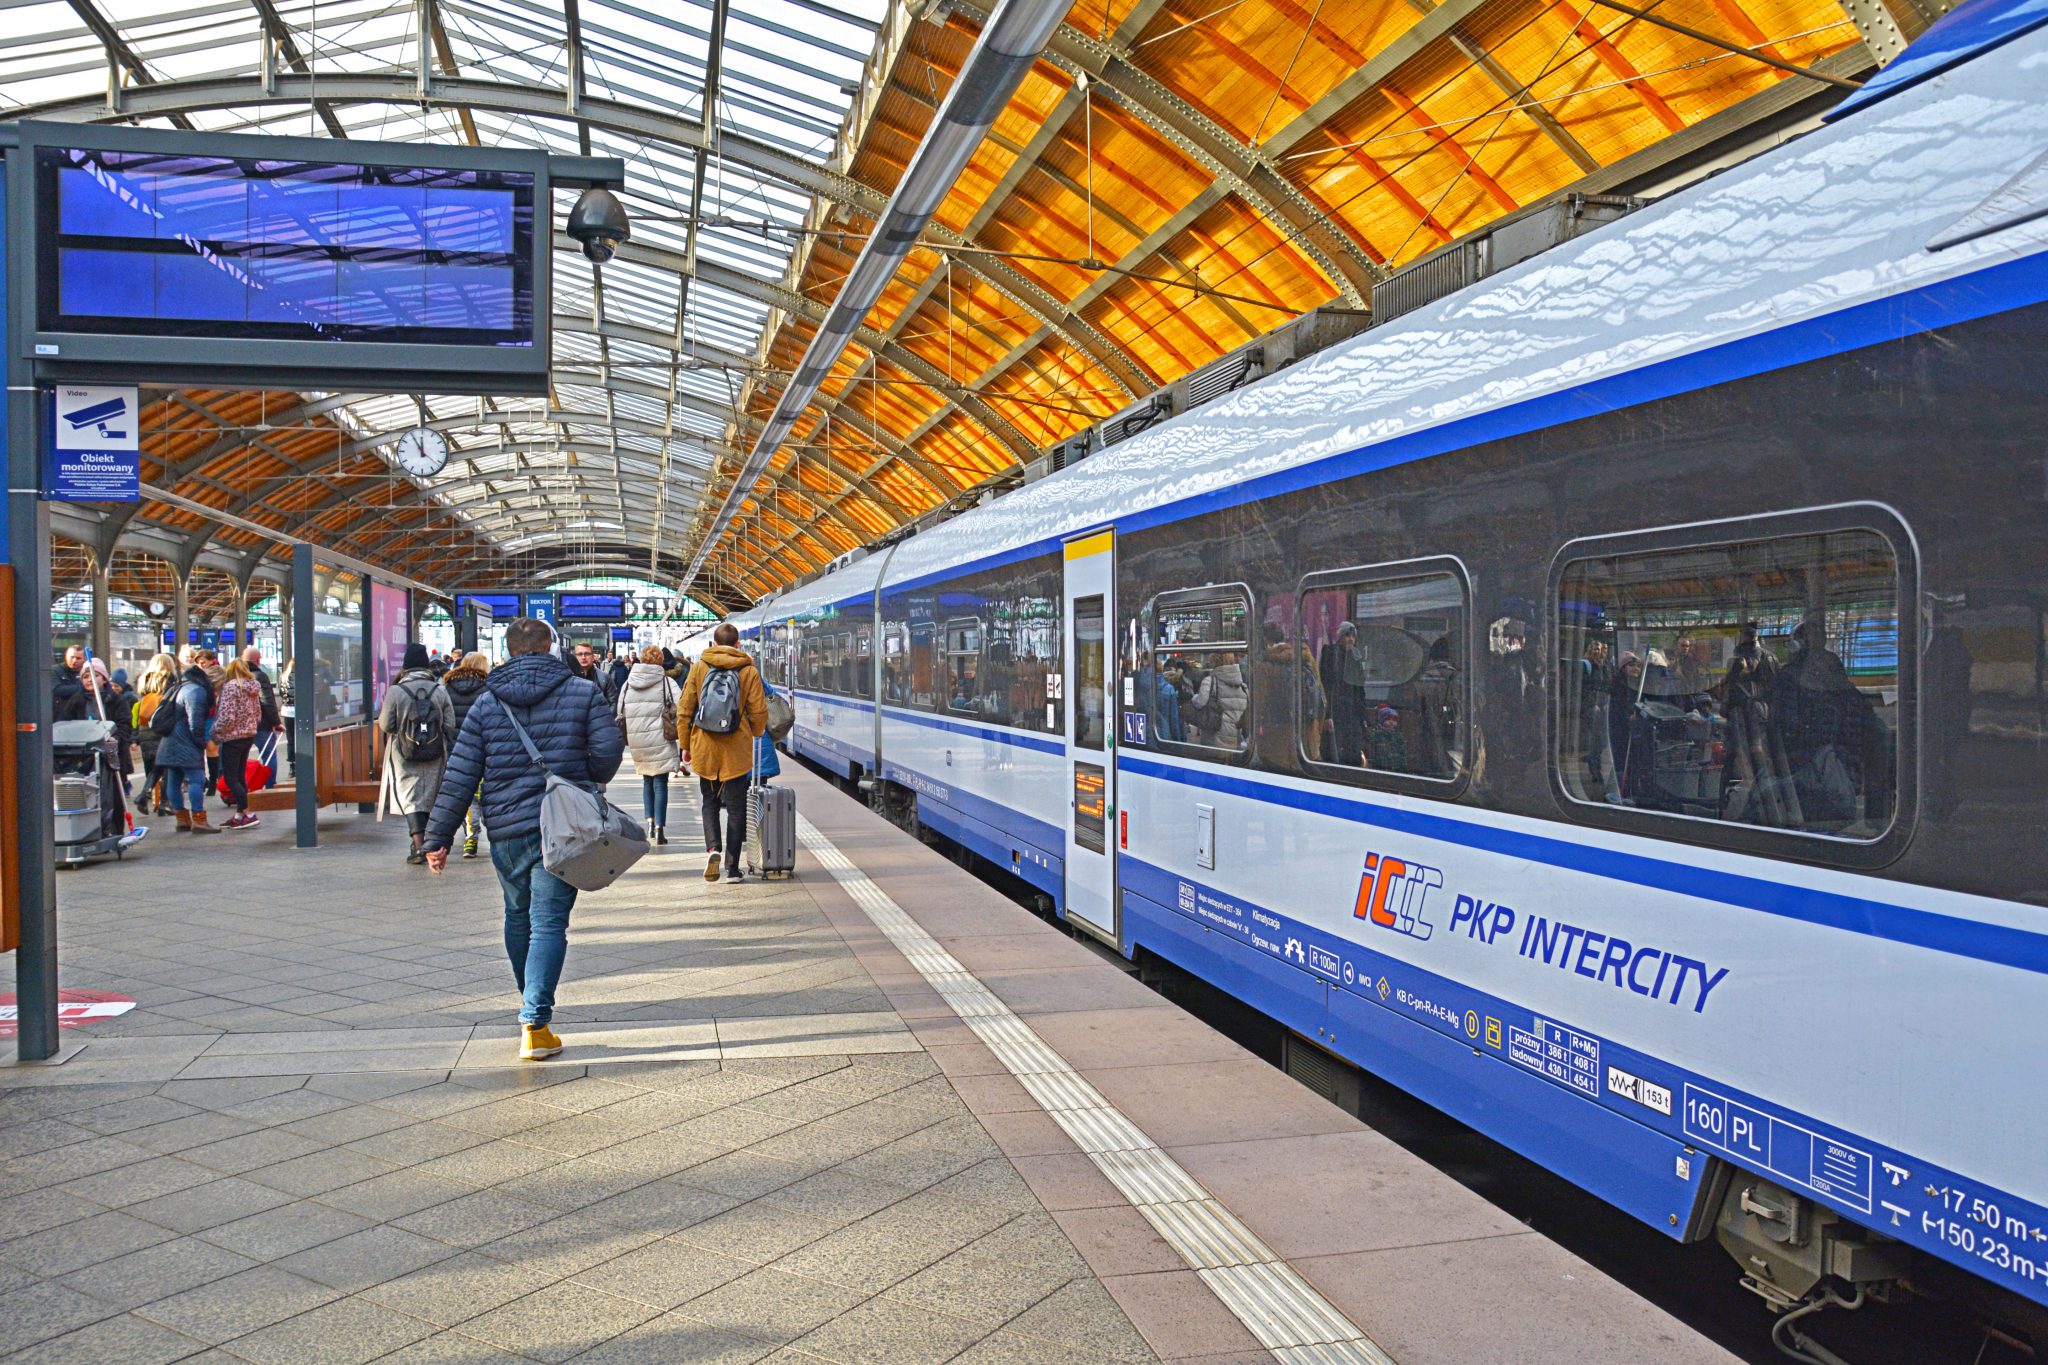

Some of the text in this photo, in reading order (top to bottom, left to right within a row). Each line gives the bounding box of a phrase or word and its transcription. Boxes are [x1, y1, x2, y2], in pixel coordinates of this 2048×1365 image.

[80, 453, 114, 463] Obiekt
[61, 463, 134, 474] monitorowany
[536, 609, 546, 620] B
[1252, 909, 1280, 931] Klimatyzacja
[1251, 933, 1269, 950] Ogrzew.
[1312, 951, 1337, 973] R 100m
[1449, 894, 1515, 945] PKP
[1518, 914, 1730, 1013] INTERCITY
[1396, 988, 1407, 1003] KB
[1468, 1015, 1475, 1033] D
[1515, 1032, 1541, 1052] próżny
[1548, 1044, 1562, 1060] 386
[1573, 1055, 1589, 1071] 408
[1554, 1030, 1596, 1057] R R+Mg
[1512, 1045, 1543, 1070] ładowny
[1547, 1062, 1562, 1077] 430
[1573, 1073, 1589, 1088] 454
[1646, 1088, 1662, 1105] 153
[1687, 1098, 1723, 1134] 160
[1733, 1116, 1761, 1152] PL
[1827, 1145, 1857, 1163] 3000V dc
[1812, 1179, 1831, 1193] 1200A
[1940, 1186, 2027, 1241] 17.50 m
